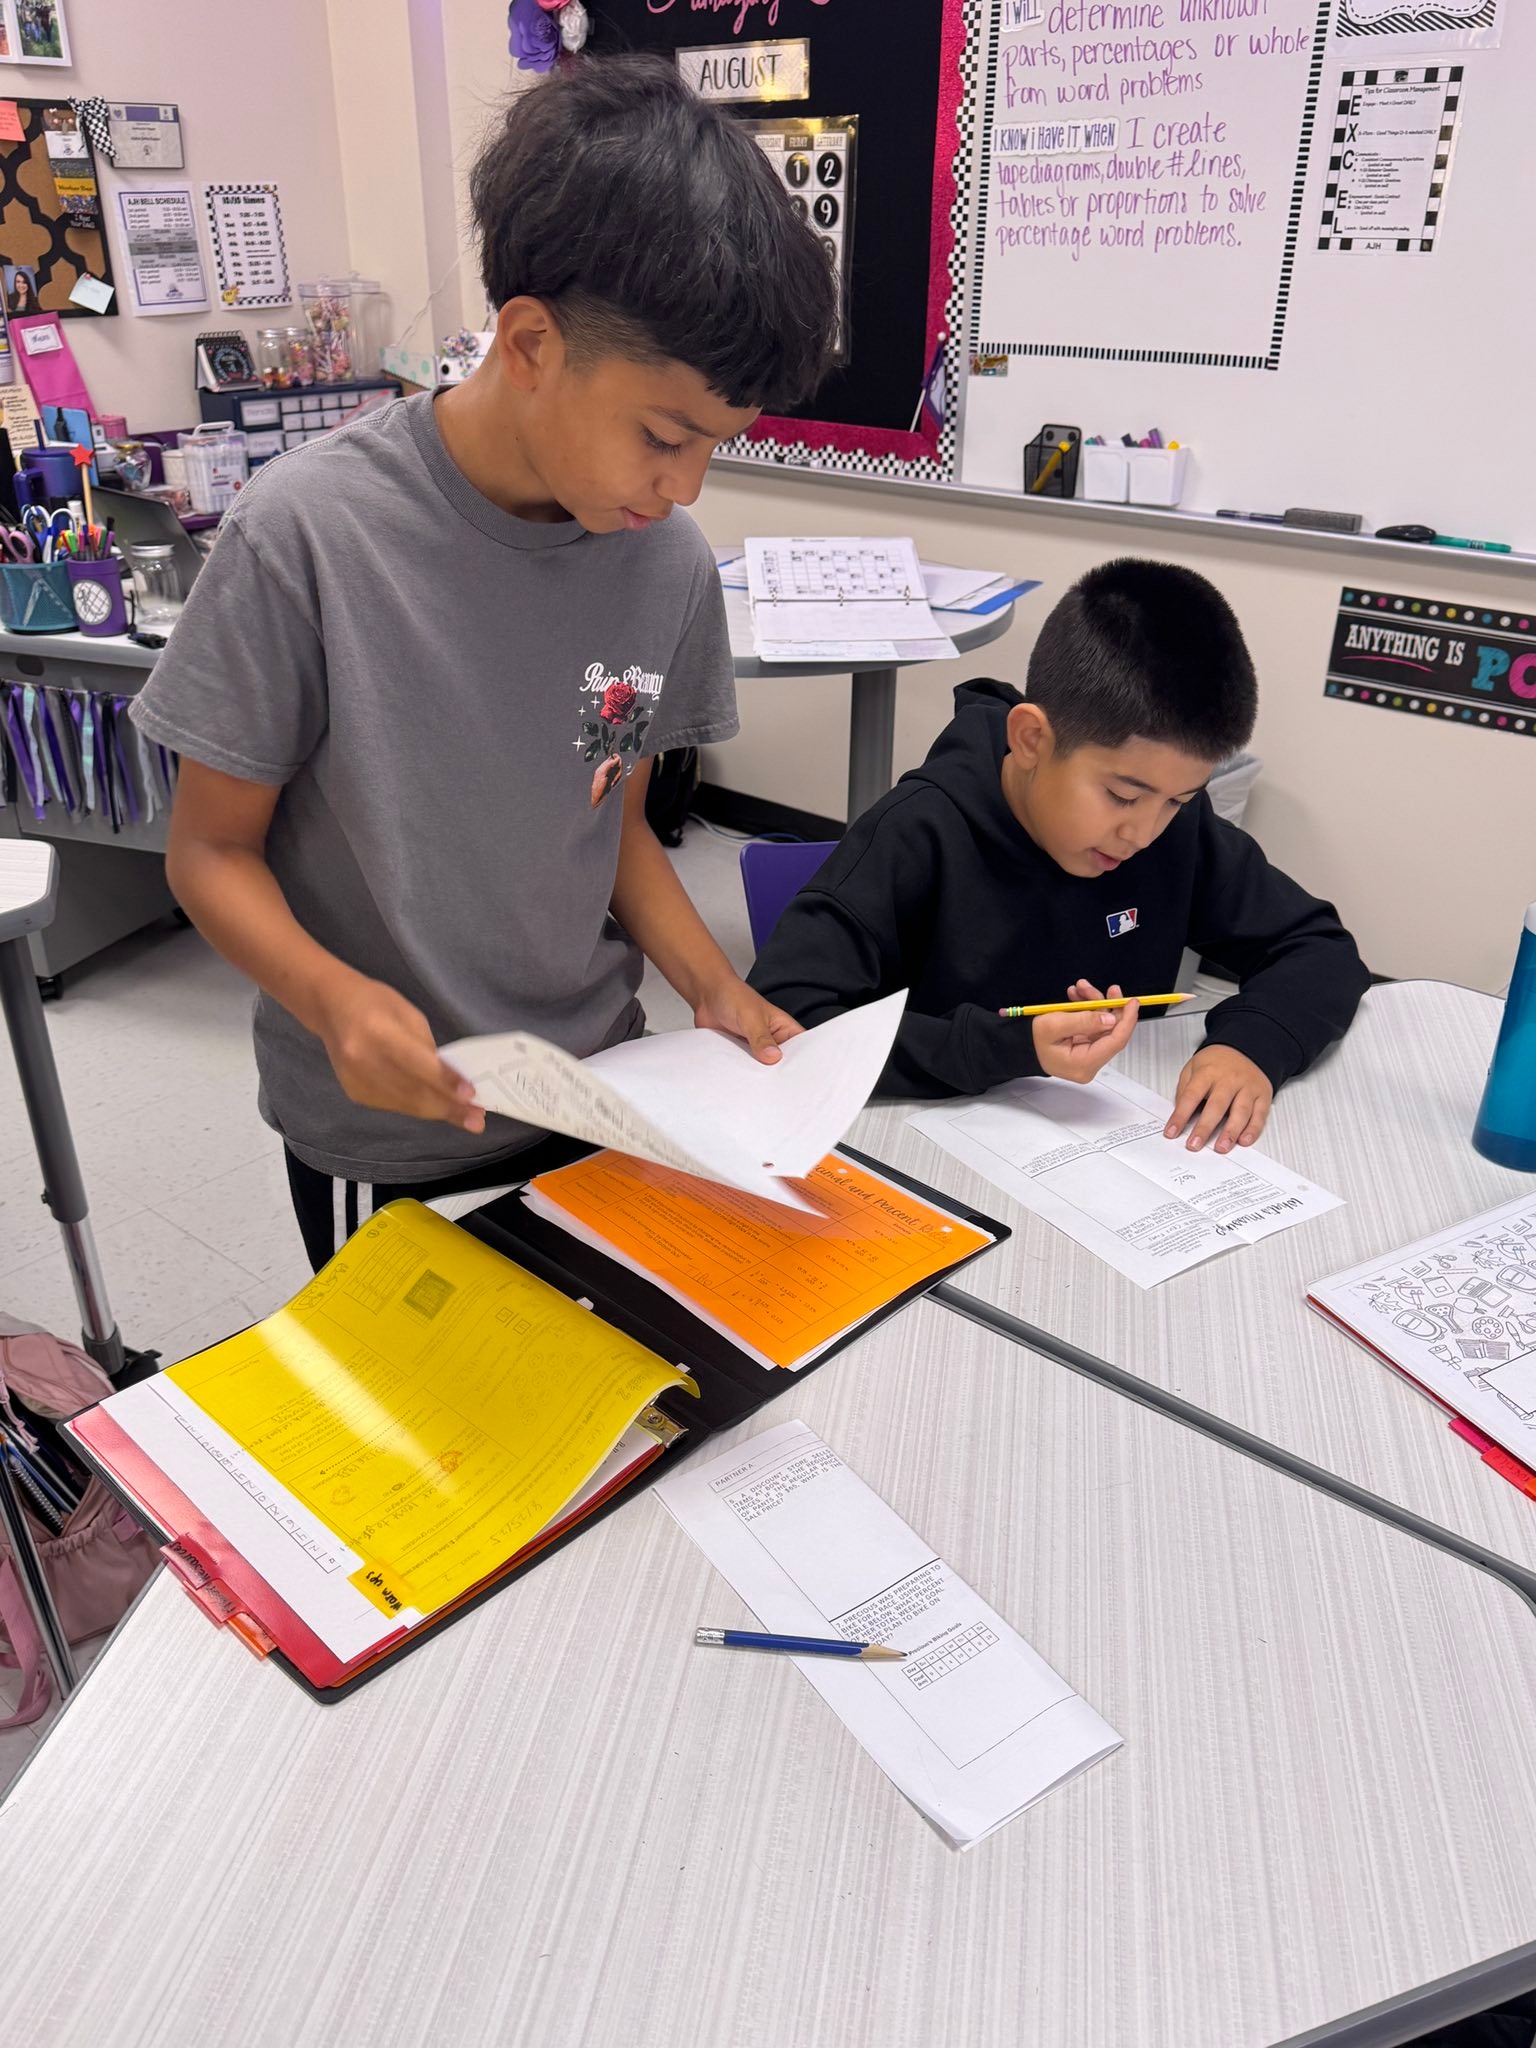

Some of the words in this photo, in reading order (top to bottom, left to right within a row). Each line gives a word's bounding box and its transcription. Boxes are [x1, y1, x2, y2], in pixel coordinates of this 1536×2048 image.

[1048, 0, 1164, 34] determine
[1180, 0, 1269, 23] unknown
[1002, 40, 1066, 72] parts,
[1071, 36, 1198, 76] percentages
[1214, 33, 1239, 58] or
[1249, 26, 1310, 55] whole
[700, 54, 782, 92] AUGUST
[1003, 75, 1047, 109] from
[1057, 72, 1109, 103] word
[1120, 67, 1204, 105] problems
[1383, 86, 1409, 94] Classroom
[1350, 95, 1362, 116] E
[1000, 127, 1028, 150] KNOW
[1067, 125, 1081, 148] IT
[1126, 116, 1146, 149] I
[1153, 112, 1226, 149] create
[1346, 123, 1359, 143] X
[793, 160, 801, 181] 1
[823, 158, 836, 182] 2
[1107, 153, 1164, 181] double
[1343, 150, 1355, 170] C
[155, 197, 186, 205] SCHEDULE
[820, 199, 833, 224] 9
[994, 189, 1055, 218] tables
[1060, 193, 1077, 217] or
[1087, 188, 1188, 222] proportions
[1200, 184, 1218, 213] to
[1229, 183, 1266, 214] solve
[1337, 190, 1349, 209] E
[996, 225, 1091, 261] percentage
[1100, 220, 1144, 247] word
[1154, 220, 1242, 253] problems.
[1333, 217, 1343, 234] L
[1365, 242, 1382, 250] AJH
[1344, 624, 1441, 662] ANYTHING
[1444, 640, 1466, 666] IS
[631, 665, 664, 701] Beauty
[814, 1163, 854, 1188] cimal
[847, 1184, 875, 1201] and
[873, 1197, 919, 1225] Percent
[1261, 1196, 1303, 1219] What's
[715, 1466, 748, 1488] PARTNER
[733, 1496, 753, 1509] ITEMS
[792, 1467, 806, 1476] THE
[807, 1451, 834, 1469] REGULAR
[750, 1472, 783, 1493] DISCOUNT
[787, 1458, 808, 1472] STORE
[752, 1497, 774, 1512] PANTS
[801, 1472, 820, 1485] WHAT
[831, 1461, 843, 1471] THE
[773, 1483, 786, 1493] THE
[789, 1465, 819, 1485] REGULAR
[820, 1456, 839, 1469] PRICE
[745, 1512, 762, 1523] SALE
[761, 1498, 785, 1513] PRICE?
[364, 1568, 384, 1589] ups
[843, 1603, 877, 1625] PRECIOUS
[877, 1593, 893, 1605] WAS
[892, 1570, 931, 1596] PREPARING
[930, 1564, 941, 1573] TO
[377, 1585, 403, 1612] Warm
[841, 1622, 858, 1634] BIKE
[858, 1614, 872, 1625] FOR
[871, 1608, 879, 1616] A
[898, 1585, 920, 1601] USING
[920, 1576, 935, 1587] THE
[846, 1624, 868, 1639] TABLE
[894, 1596, 915, 1611] WHAT
[914, 1578, 945, 1598] PERCENT
[861, 1627, 876, 1638] HER
[876, 1614, 899, 1630] TOTAL
[897, 1599, 925, 1617] WEEKLY
[925, 1586, 945, 1601] GOAL
[869, 1631, 884, 1642] SHE
[883, 1620, 903, 1634] PLAN
[902, 1614, 913, 1623] TO
[913, 1604, 929, 1616] BIKE
[928, 1597, 941, 1607] ON
[931, 1630, 949, 1643] Biking
[947, 1622, 962, 1633] Goals
